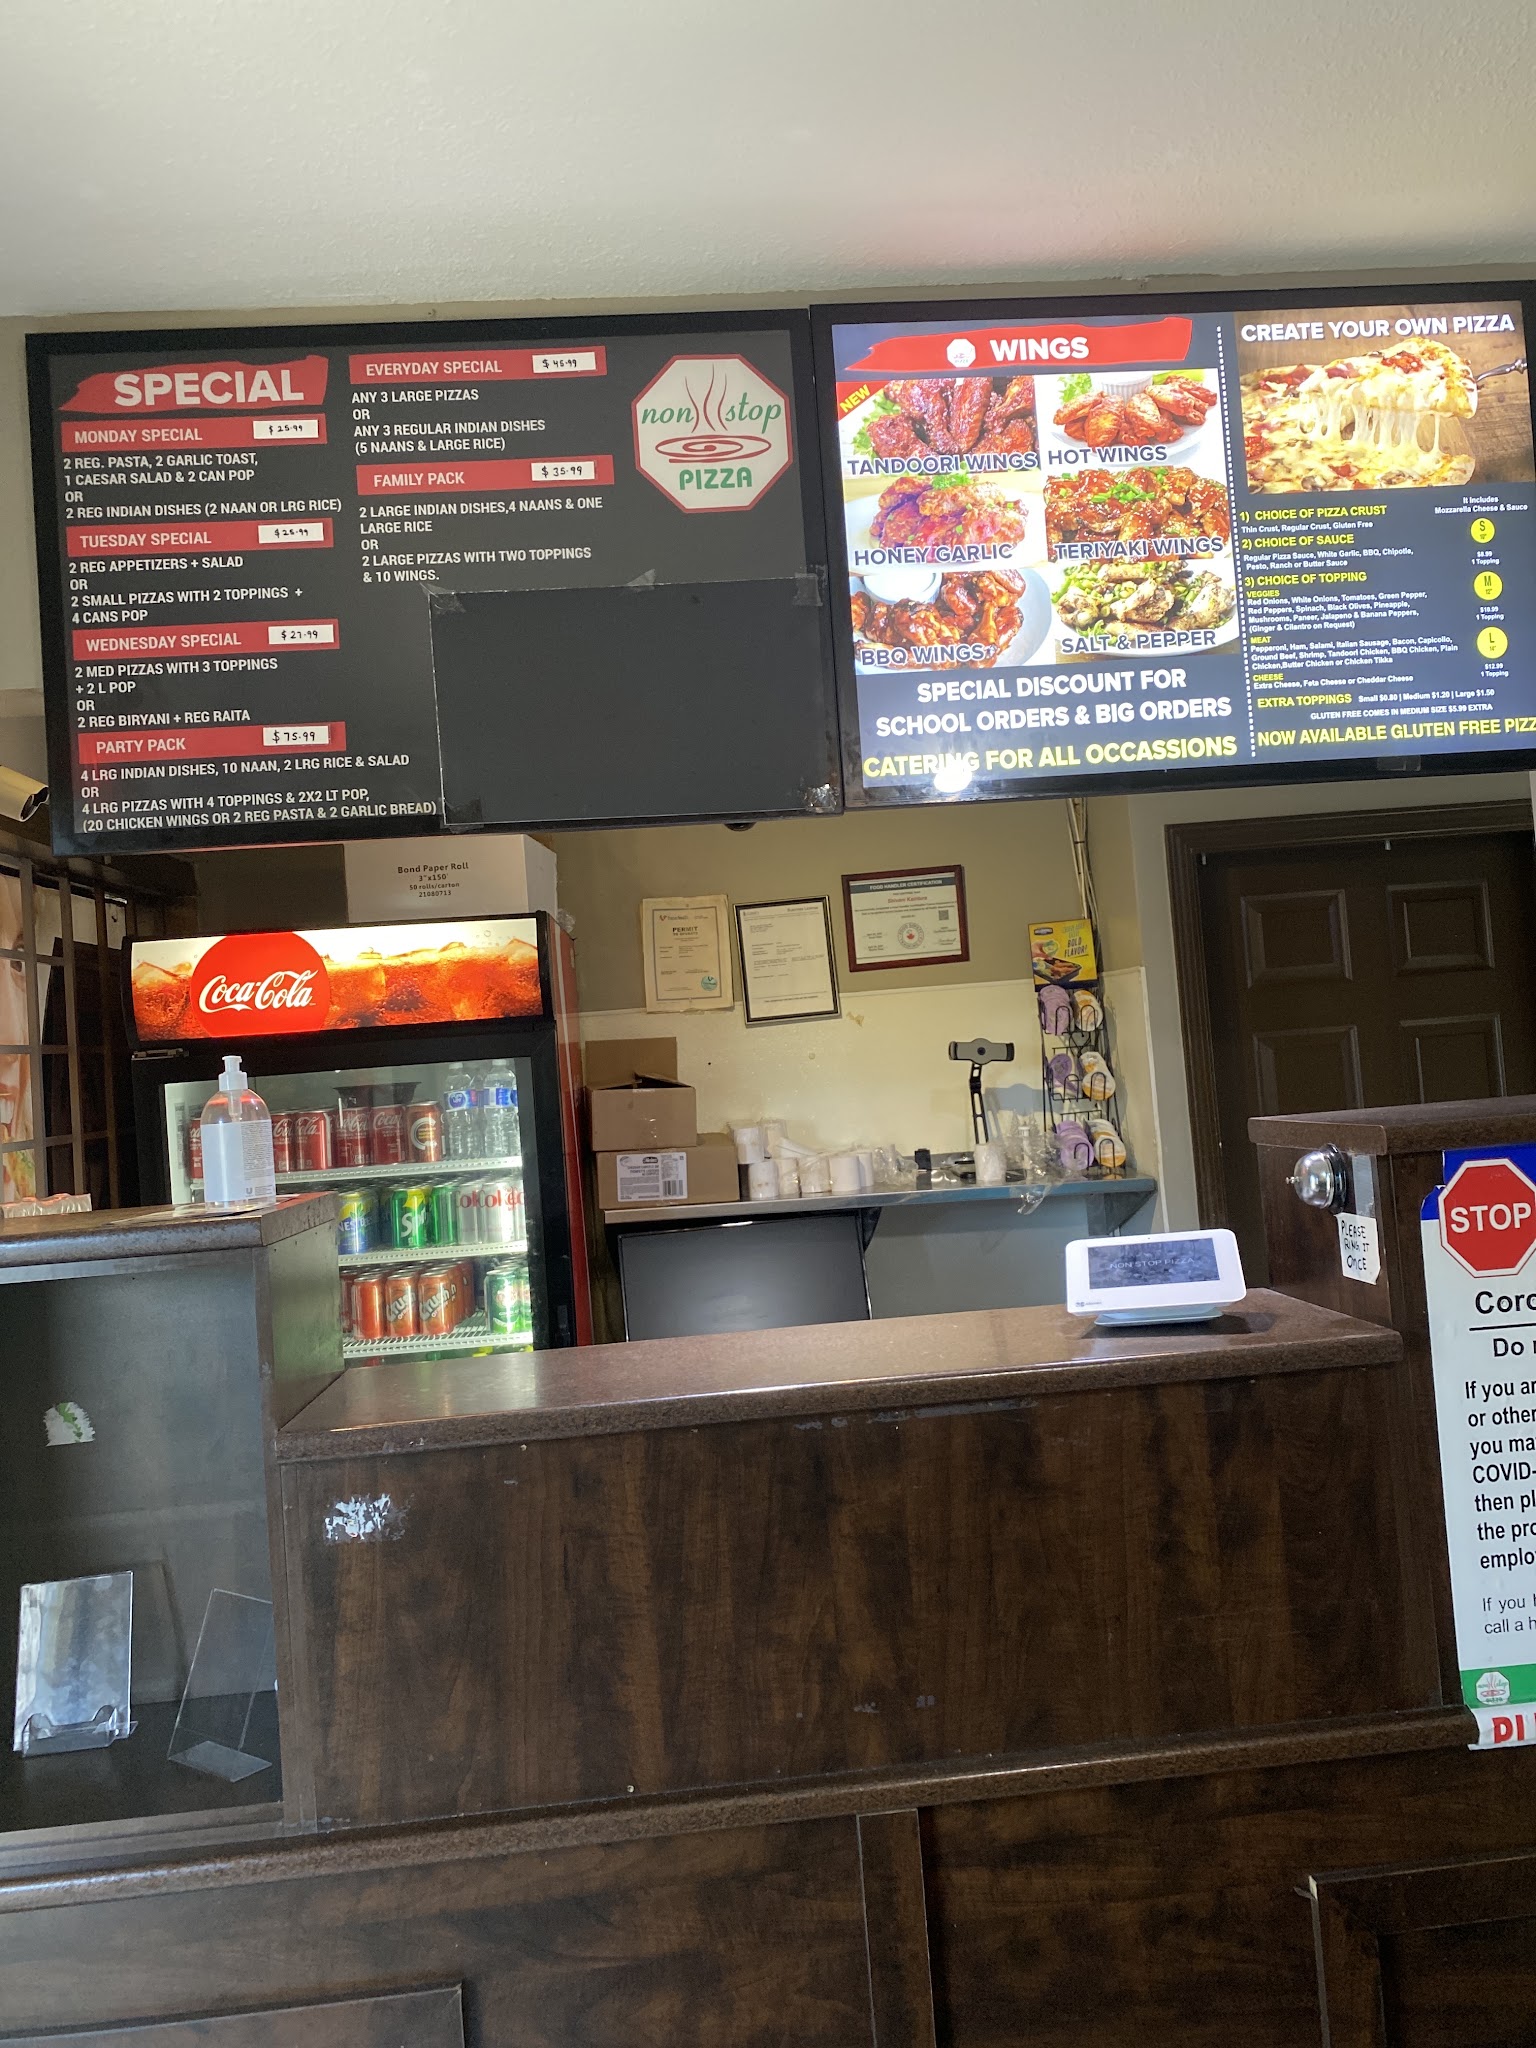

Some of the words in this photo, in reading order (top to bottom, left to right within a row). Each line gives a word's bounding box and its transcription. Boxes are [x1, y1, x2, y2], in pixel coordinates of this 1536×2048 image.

[1240, 321, 1324, 341] CREATE
[1327, 319, 1390, 338] YOUR
[1394, 316, 1447, 336] OWN
[1452, 313, 1514, 334] PIZZA
[989, 336, 1089, 361] WINGS
[366, 361, 439, 376] EVERYDAY
[442, 360, 502, 374] SPECIAL
[114, 369, 304, 406] SPECIAL
[840, 384, 870, 412] NEW
[642, 404, 694, 425] non
[725, 392, 782, 434] stop
[74, 429, 137, 443] MONDAY
[141, 427, 203, 442] SPECIAL
[353, 424, 379, 436] ANY
[382, 424, 390, 436] 3
[393, 422, 451, 435] REGULAR
[454, 420, 497, 433] INDIAN
[500, 419, 545, 432] DISHES
[354, 441, 367, 456] (5
[370, 440, 414, 453] NAANS
[417, 439, 426, 451] &
[429, 438, 470, 450] LARGE
[472, 436, 505, 451] RICE)
[1048, 450, 1092, 465] HOT
[1096, 446, 1168, 462] WINGS
[63, 457, 71, 469] 2
[74, 456, 104, 469] REG.
[107, 455, 152, 468] PASTA,
[154, 455, 163, 466] 2
[166, 453, 212, 466] GARLIC
[214, 452, 258, 466] TOAST,
[848, 456, 960, 476] TANDOORI
[966, 453, 1037, 470] WINGS
[373, 472, 423, 487] FAMILY
[427, 471, 464, 485] PACK
[679, 467, 752, 490] PIZZA
[1240, 511, 1250, 523] 1)
[1254, 508, 1297, 520] CHOICE
[1298, 508, 1314, 518] OF
[1316, 506, 1348, 517] PIZZA
[1349, 504, 1386, 516] CRUST
[79, 533, 146, 548] TUESDAY
[150, 531, 212, 545] SPECIAL
[1056, 540, 1147, 559] TERIYAKI
[1152, 537, 1224, 554] WINGS
[1242, 538, 1252, 550] 2)
[1254, 536, 1296, 548] CHOICE
[1298, 535, 1314, 545] OF
[1316, 533, 1354, 544] SAUCE
[68, 562, 77, 573] 2
[79, 560, 105, 573] REG
[108, 557, 187, 572] APPETIZERS
[190, 558, 198, 567] +
[201, 555, 243, 568] SALAD
[361, 555, 370, 566] 2
[372, 553, 414, 566] LARGE
[416, 551, 461, 564] PIZZAS
[463, 550, 495, 563] WITH
[498, 549, 526, 561] TWO
[528, 546, 591, 560] TOPPINGS
[854, 547, 928, 566] HONEY
[936, 543, 1014, 562] GARLIC
[362, 571, 372, 582] &
[375, 570, 390, 582] 10
[393, 569, 439, 581] WINGS.
[1246, 589, 1280, 597] VEGGIES
[85, 635, 176, 651] WEDNESDAY
[180, 632, 242, 647] SPECIAL
[1062, 635, 1108, 654] SALT
[1116, 634, 1131, 650] &
[1137, 631, 1216, 649] PEPPER
[862, 648, 907, 666] BBQ
[914, 644, 986, 663] WINGS
[916, 678, 1011, 703] SPECIAL
[1016, 670, 1134, 697] DISCOUNT
[1140, 668, 1186, 690] FOR
[1257, 696, 1295, 708] EXTRA
[1295, 693, 1352, 705] TOPPINGS
[875, 712, 972, 737] SCHOOL
[975, 706, 1069, 731] ORDERS
[1073, 704, 1090, 725] &
[1094, 702, 1134, 723] BIG
[1139, 696, 1232, 721] ORDERS
[1309, 711, 1340, 720] GLUTEN
[1341, 709, 1362, 718] FREE
[1362, 708, 1390, 717] COMES
[1399, 706, 1429, 715] MEDIUM
[1430, 705, 1447, 713] SIZE
[1467, 703, 1493, 711] EXTRA
[1257, 729, 1296, 746] NOW
[1299, 724, 1387, 744] AVAILABLE
[1390, 721, 1455, 739] GLUTEN
[1458, 718, 1501, 735] FREE
[96, 739, 143, 753] PARTY
[147, 737, 186, 751] PACK
[986, 748, 1034, 770] FOR
[1038, 744, 1080, 768] ALL
[1086, 736, 1238, 764] OCCASSIONS
[82, 819, 103, 833] (20
[106, 815, 162, 830] CHICKEN
[165, 813, 209, 826] WINGS
[211, 812, 230, 824] OR
[232, 811, 241, 823] 2
[244, 809, 270, 822] REG
[272, 807, 314, 820] PASTA
[316, 806, 326, 818] &
[329, 806, 338, 817] 2
[340, 803, 387, 817] GARLIC
[389, 800, 436, 815] BREAD)
[398, 865, 421, 874] Bond
[423, 865, 449, 873] Paper
[198, 970, 318, 1013] Coca-Cola
[1450, 1202, 1531, 1234] STOP
[1341, 1220, 1366, 1239] PLEASE
[1362, 1243, 1370, 1252] IT
[1135, 1260, 1162, 1268] STOP
[1493, 1338, 1524, 1357] Do
[1466, 1381, 1476, 1399] If
[1482, 1382, 1514, 1402] you
[1468, 1412, 1486, 1427] or
[1470, 1442, 1502, 1460] you
[1473, 1462, 1536, 1483] COVID-
[1475, 1494, 1514, 1512] then
[1477, 1522, 1505, 1540] the
[1480, 1548, 1536, 1571] emplo
